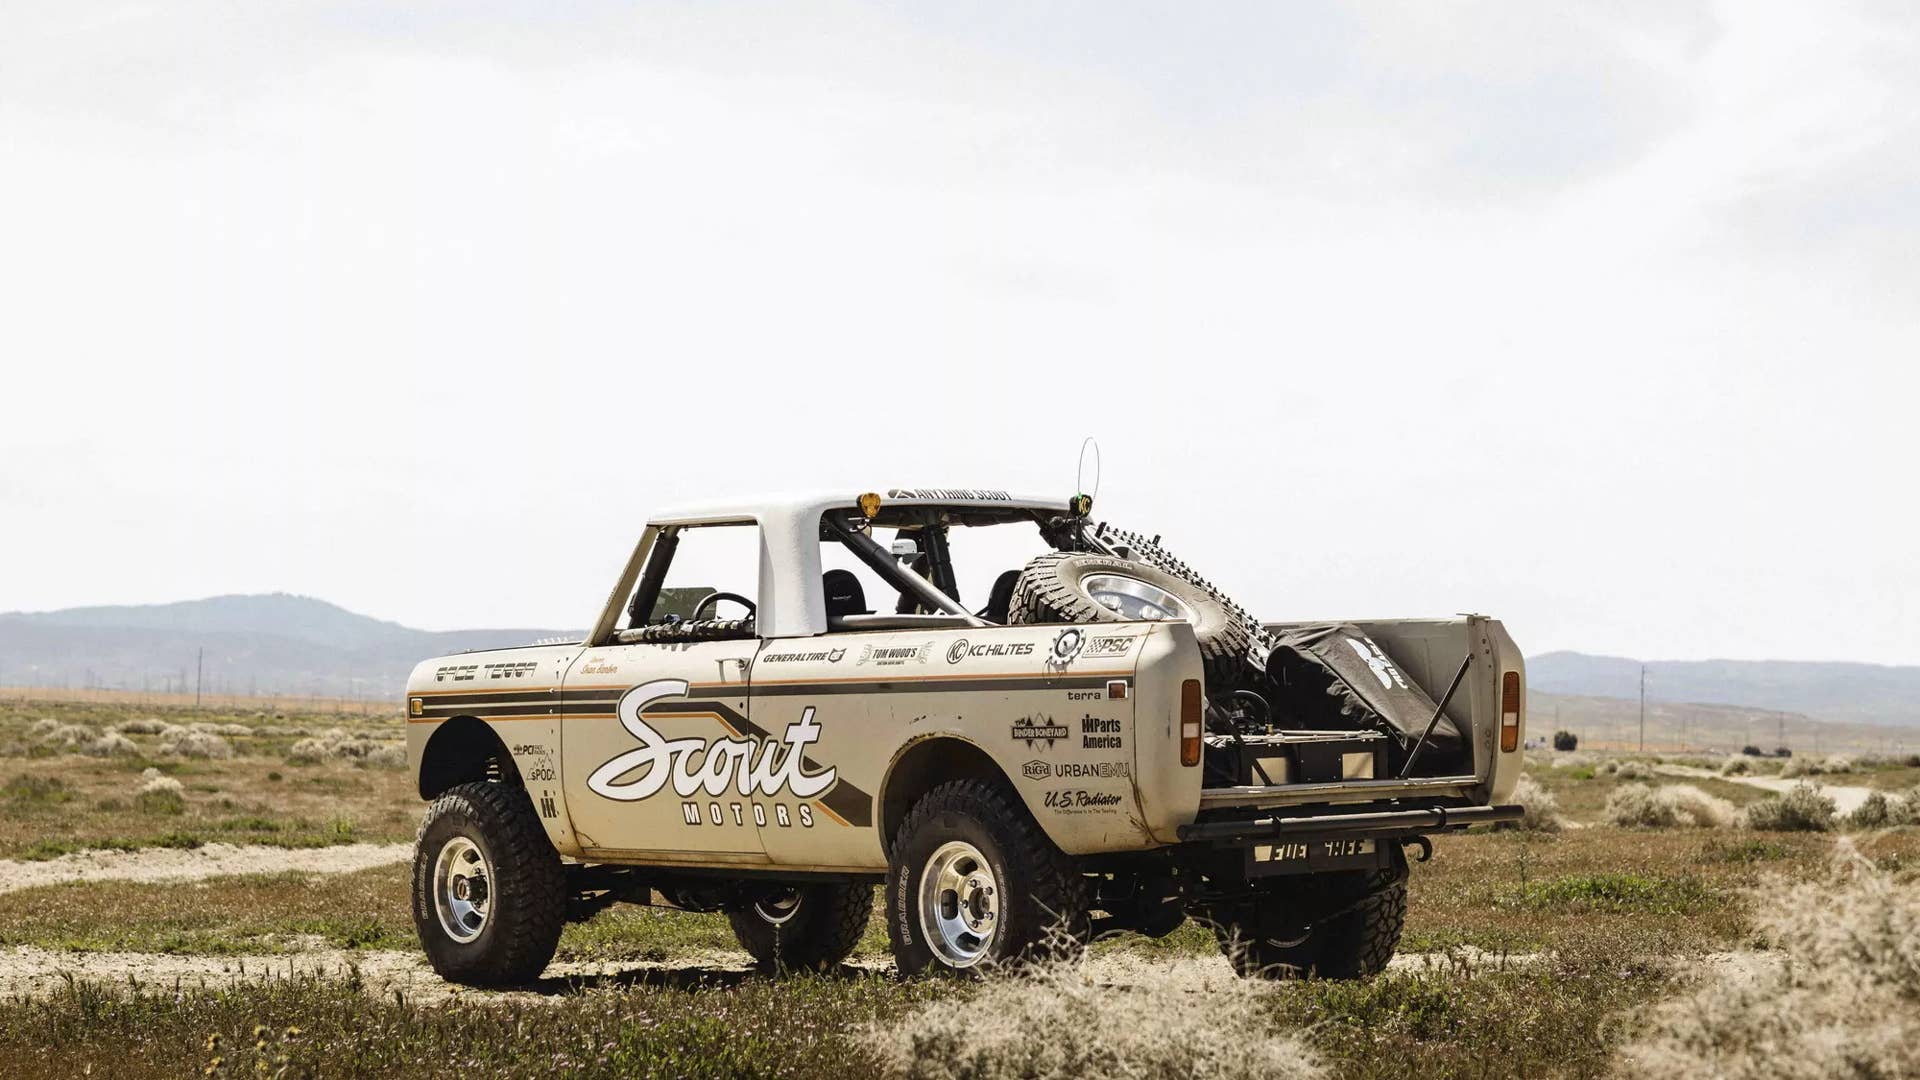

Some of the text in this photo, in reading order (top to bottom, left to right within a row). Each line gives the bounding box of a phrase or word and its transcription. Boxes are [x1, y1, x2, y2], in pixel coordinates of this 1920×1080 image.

[1101, 638, 1132, 653] PSC
[872, 648, 889, 659] TOM
[1067, 691, 1101, 700] terra
[587, 678, 837, 802] Scout
[1082, 735, 1122, 749] America
[1076, 791, 1122, 807] Radiator
[682, 800, 815, 828] MOTORS
